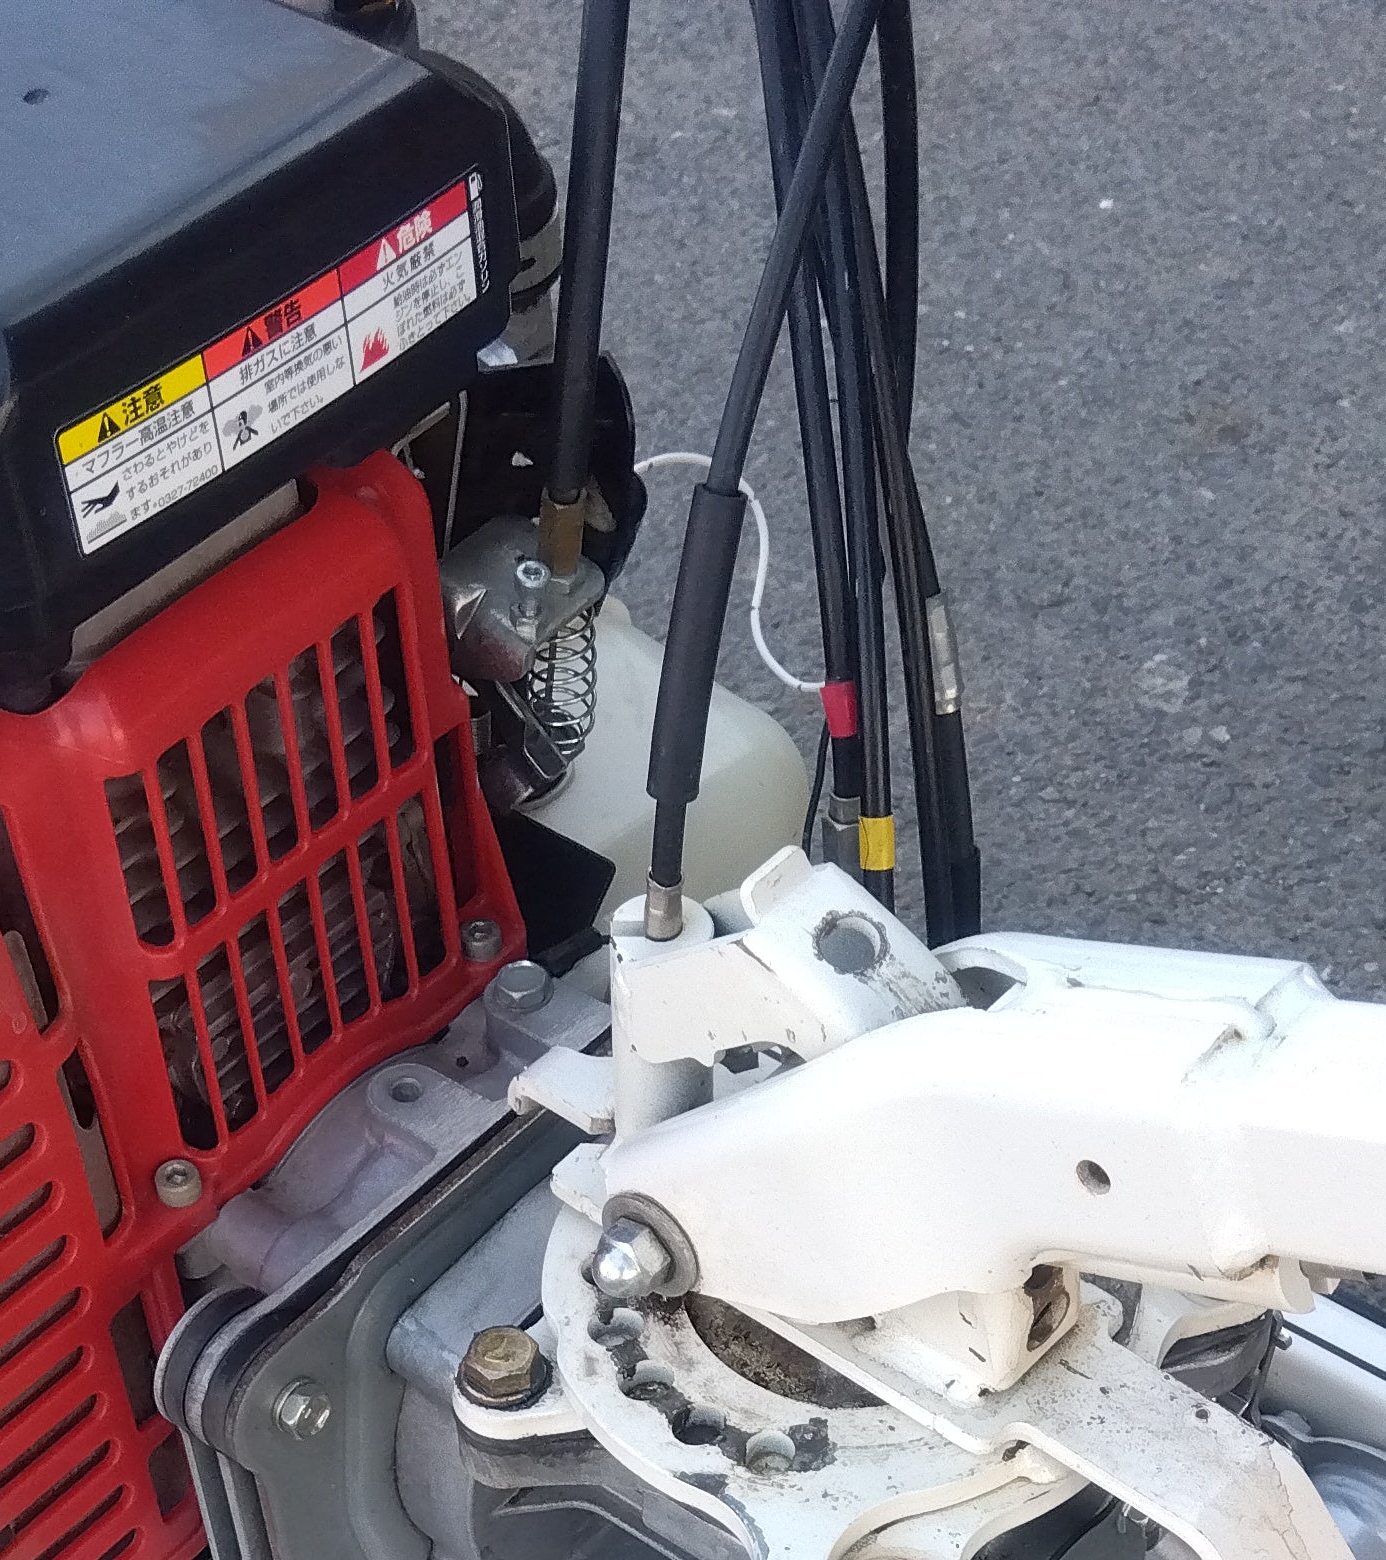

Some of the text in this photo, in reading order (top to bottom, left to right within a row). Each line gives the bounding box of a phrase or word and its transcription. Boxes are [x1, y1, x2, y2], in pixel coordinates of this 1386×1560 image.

[395, 209, 433, 254] 危険
[381, 239, 436, 292] 火気厳禁
[262, 297, 303, 341] 警告
[237, 320, 318, 386] 排ガスに注意
[263, 334, 343, 395] 室内等換気の悪い
[120, 381, 165, 426] 注意
[266, 354, 346, 414] 場所では使用しな
[269, 393, 324, 435] いで下さい。
[81, 398, 196, 474] マフラー高温注意
[120, 419, 210, 482] さわるとやけどを
[124, 440, 213, 502] するおそれがあり
